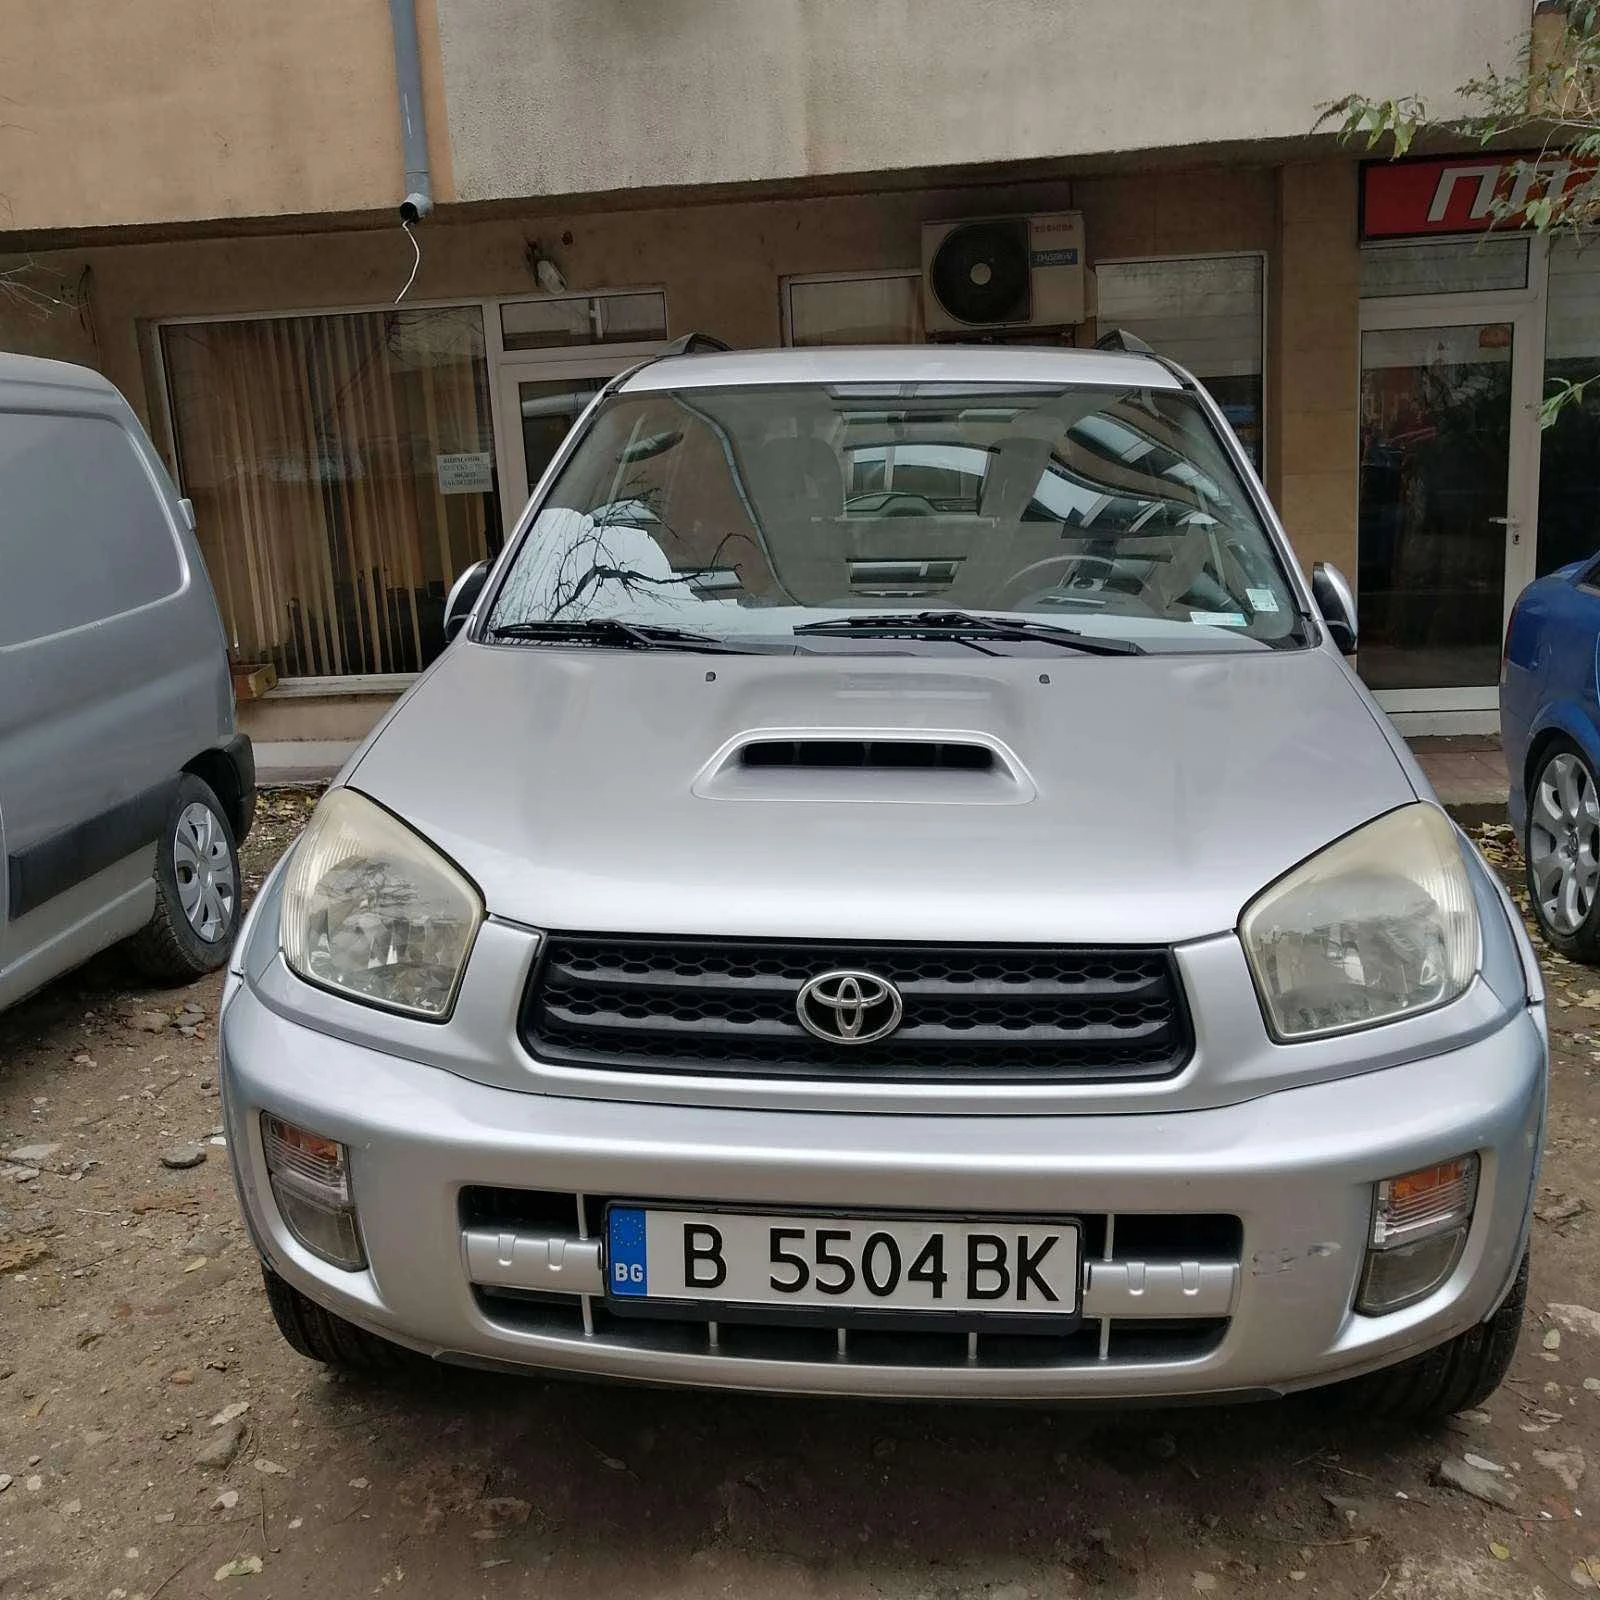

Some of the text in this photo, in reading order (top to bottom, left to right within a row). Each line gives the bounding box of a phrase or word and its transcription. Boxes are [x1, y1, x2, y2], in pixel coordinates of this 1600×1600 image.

[615, 1262, 644, 1283] BG
[683, 1223, 1060, 1301] B 5504 BK
